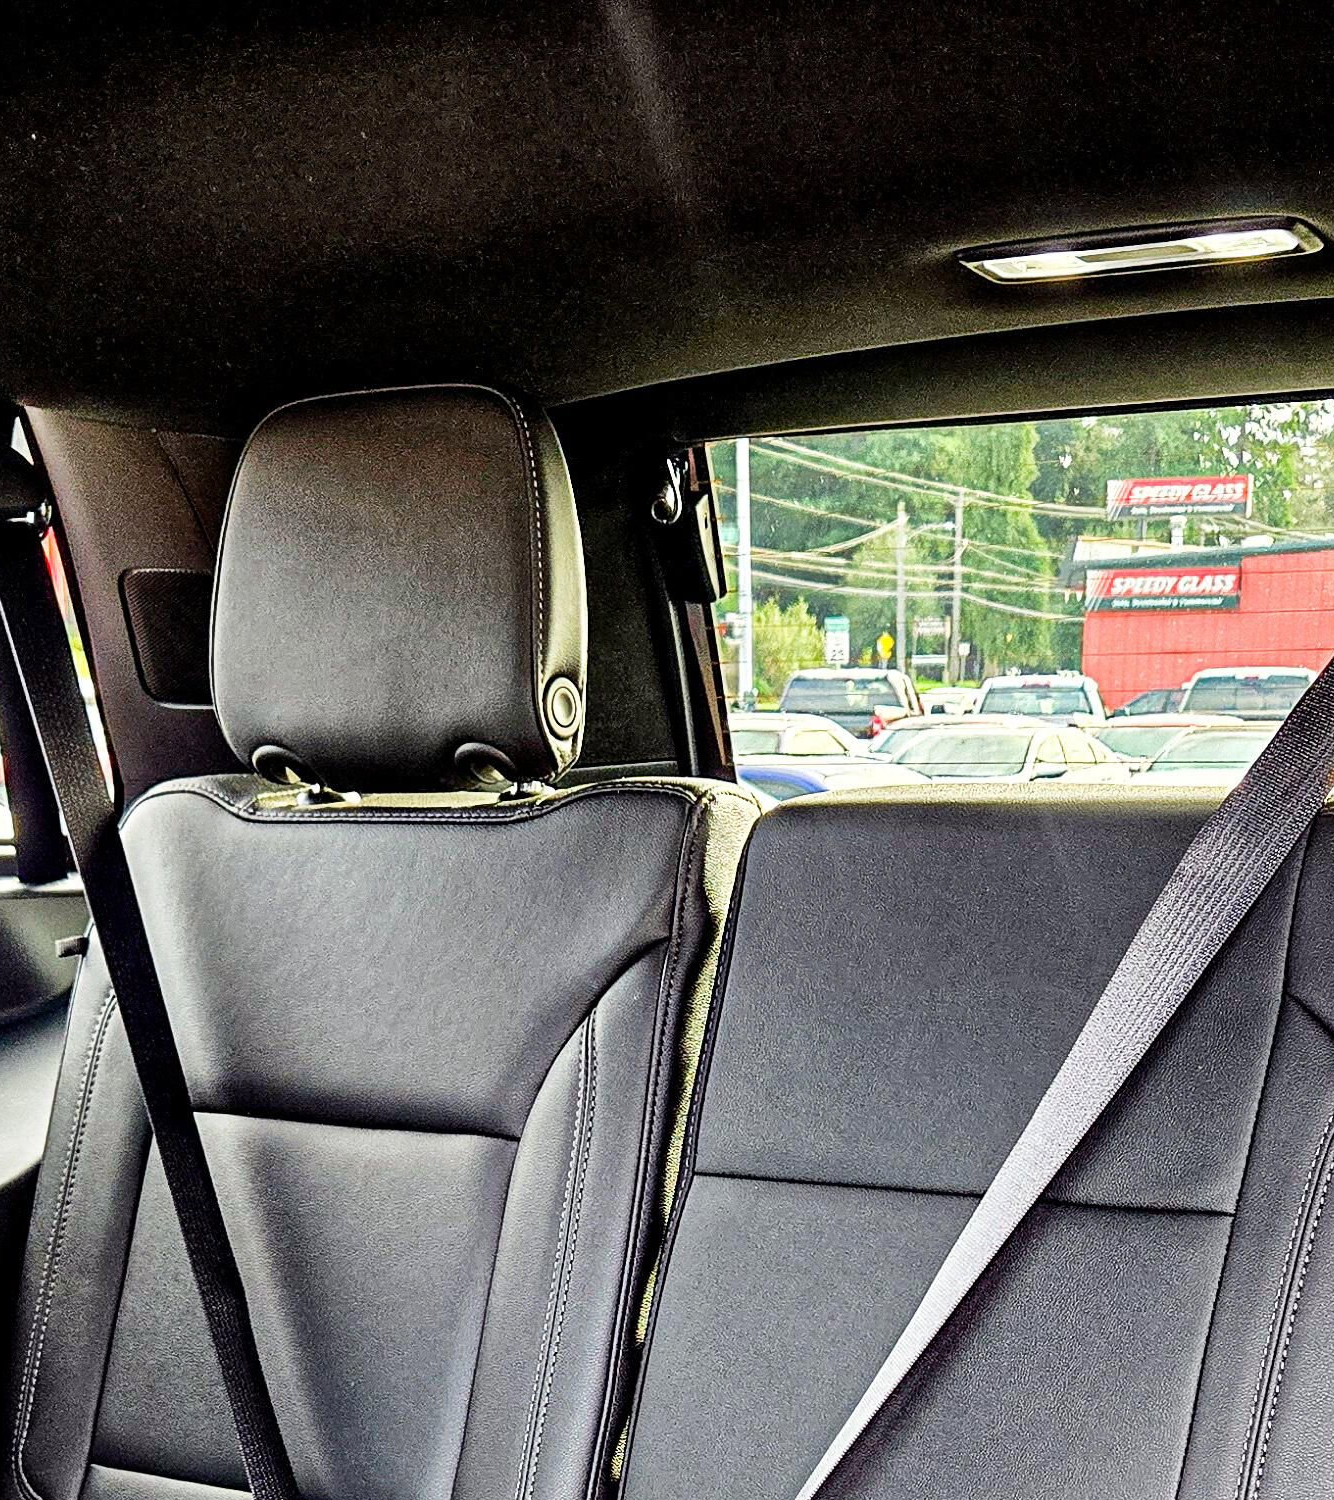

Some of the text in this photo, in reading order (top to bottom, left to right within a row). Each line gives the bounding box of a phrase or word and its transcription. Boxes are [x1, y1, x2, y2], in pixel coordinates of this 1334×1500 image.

[1129, 483, 1244, 502] SPEEDY GLASS
[1111, 574, 1236, 595] SPEEDY GLASS
